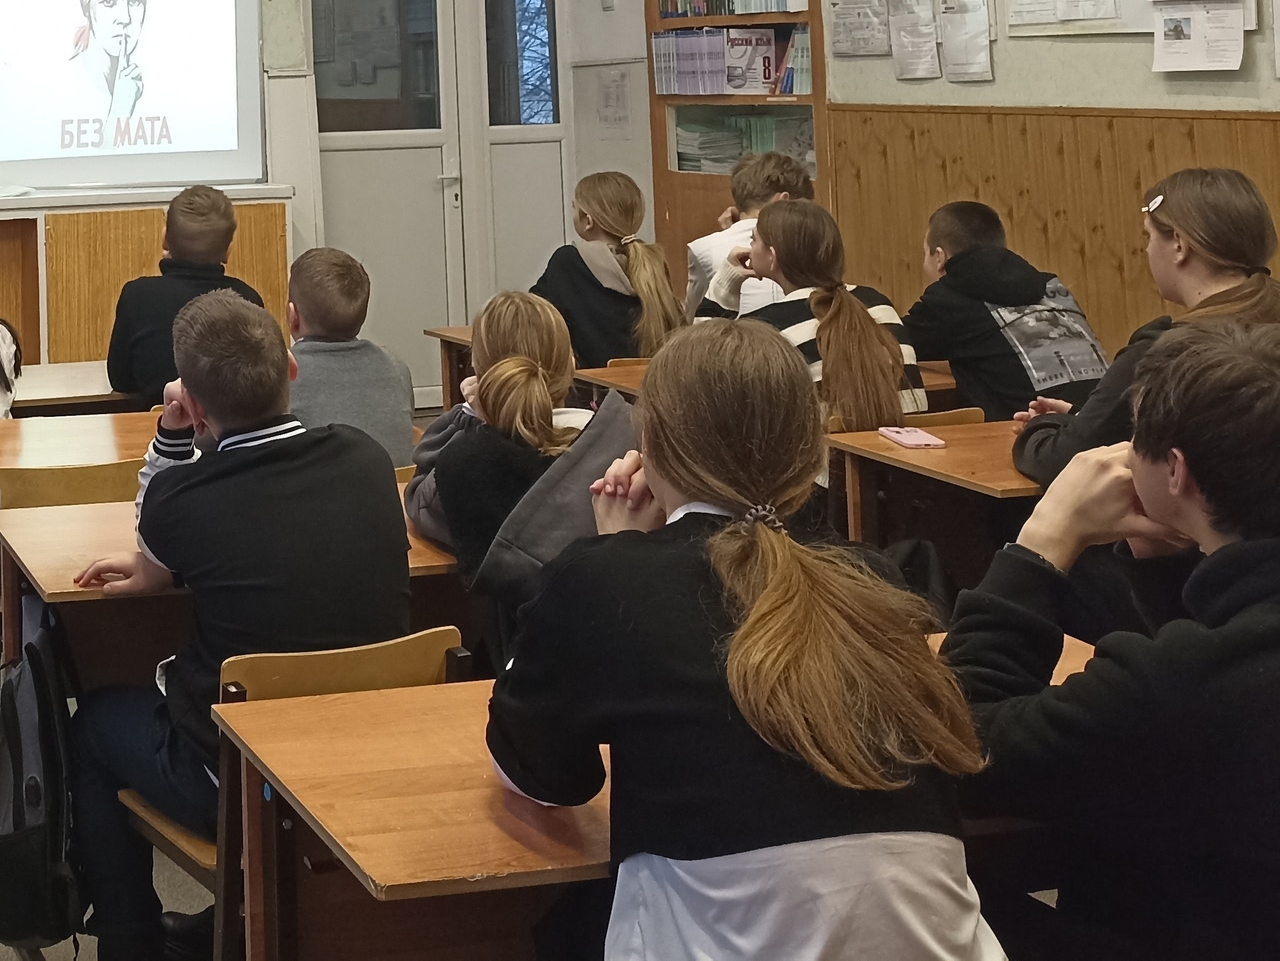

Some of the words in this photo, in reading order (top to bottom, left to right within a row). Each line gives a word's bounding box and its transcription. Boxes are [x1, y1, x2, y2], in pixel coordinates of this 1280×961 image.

[762, 55, 771, 80] 8
[60, 118, 104, 149] БЕЗ
[113, 116, 173, 147] МАТА
